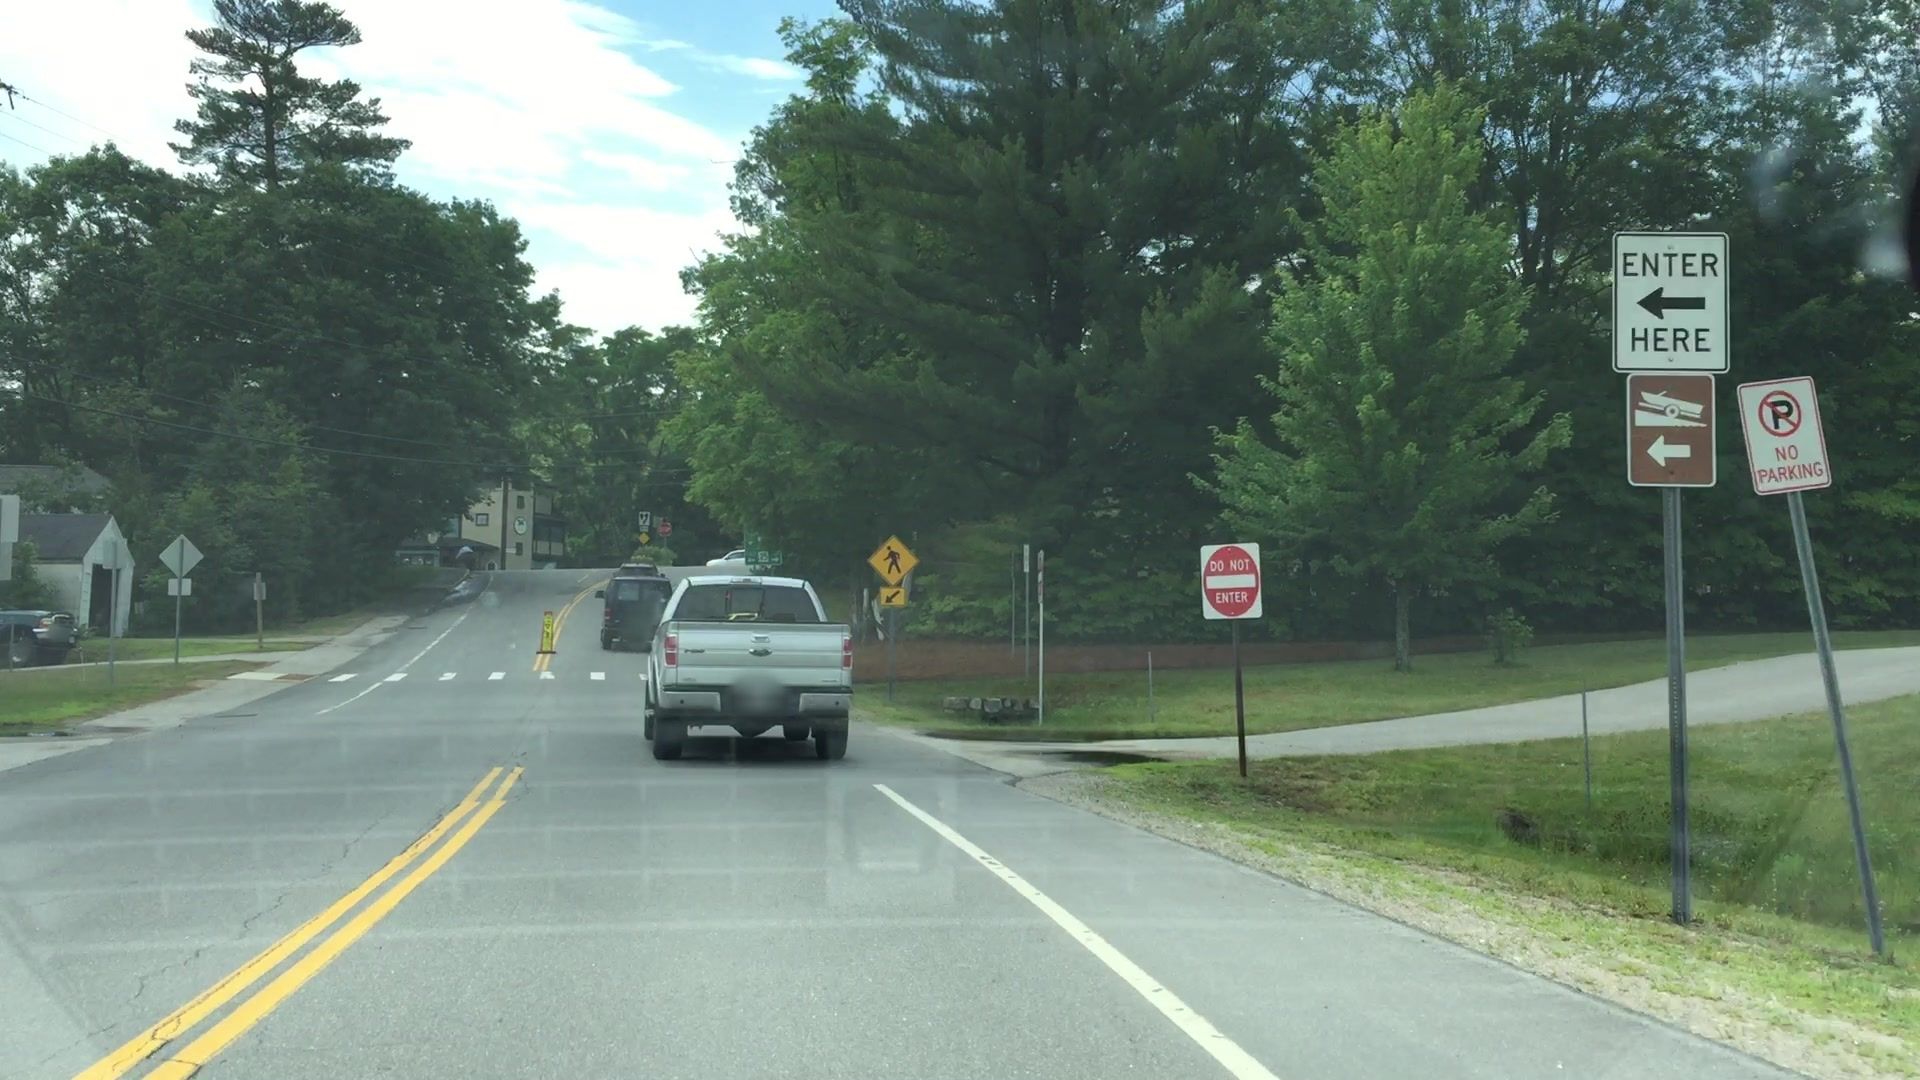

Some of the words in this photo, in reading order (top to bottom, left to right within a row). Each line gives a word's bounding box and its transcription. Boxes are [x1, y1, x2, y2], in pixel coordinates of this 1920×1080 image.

[1622, 252, 1719, 277] ENTER
[1631, 328, 1712, 352] HERE
[1775, 444, 1799, 461] NO
[1758, 462, 1823, 483] PARKING
[1210, 560, 1224, 572] DO
[1230, 559, 1250, 571] NOT
[1215, 591, 1248, 604] ENTER
